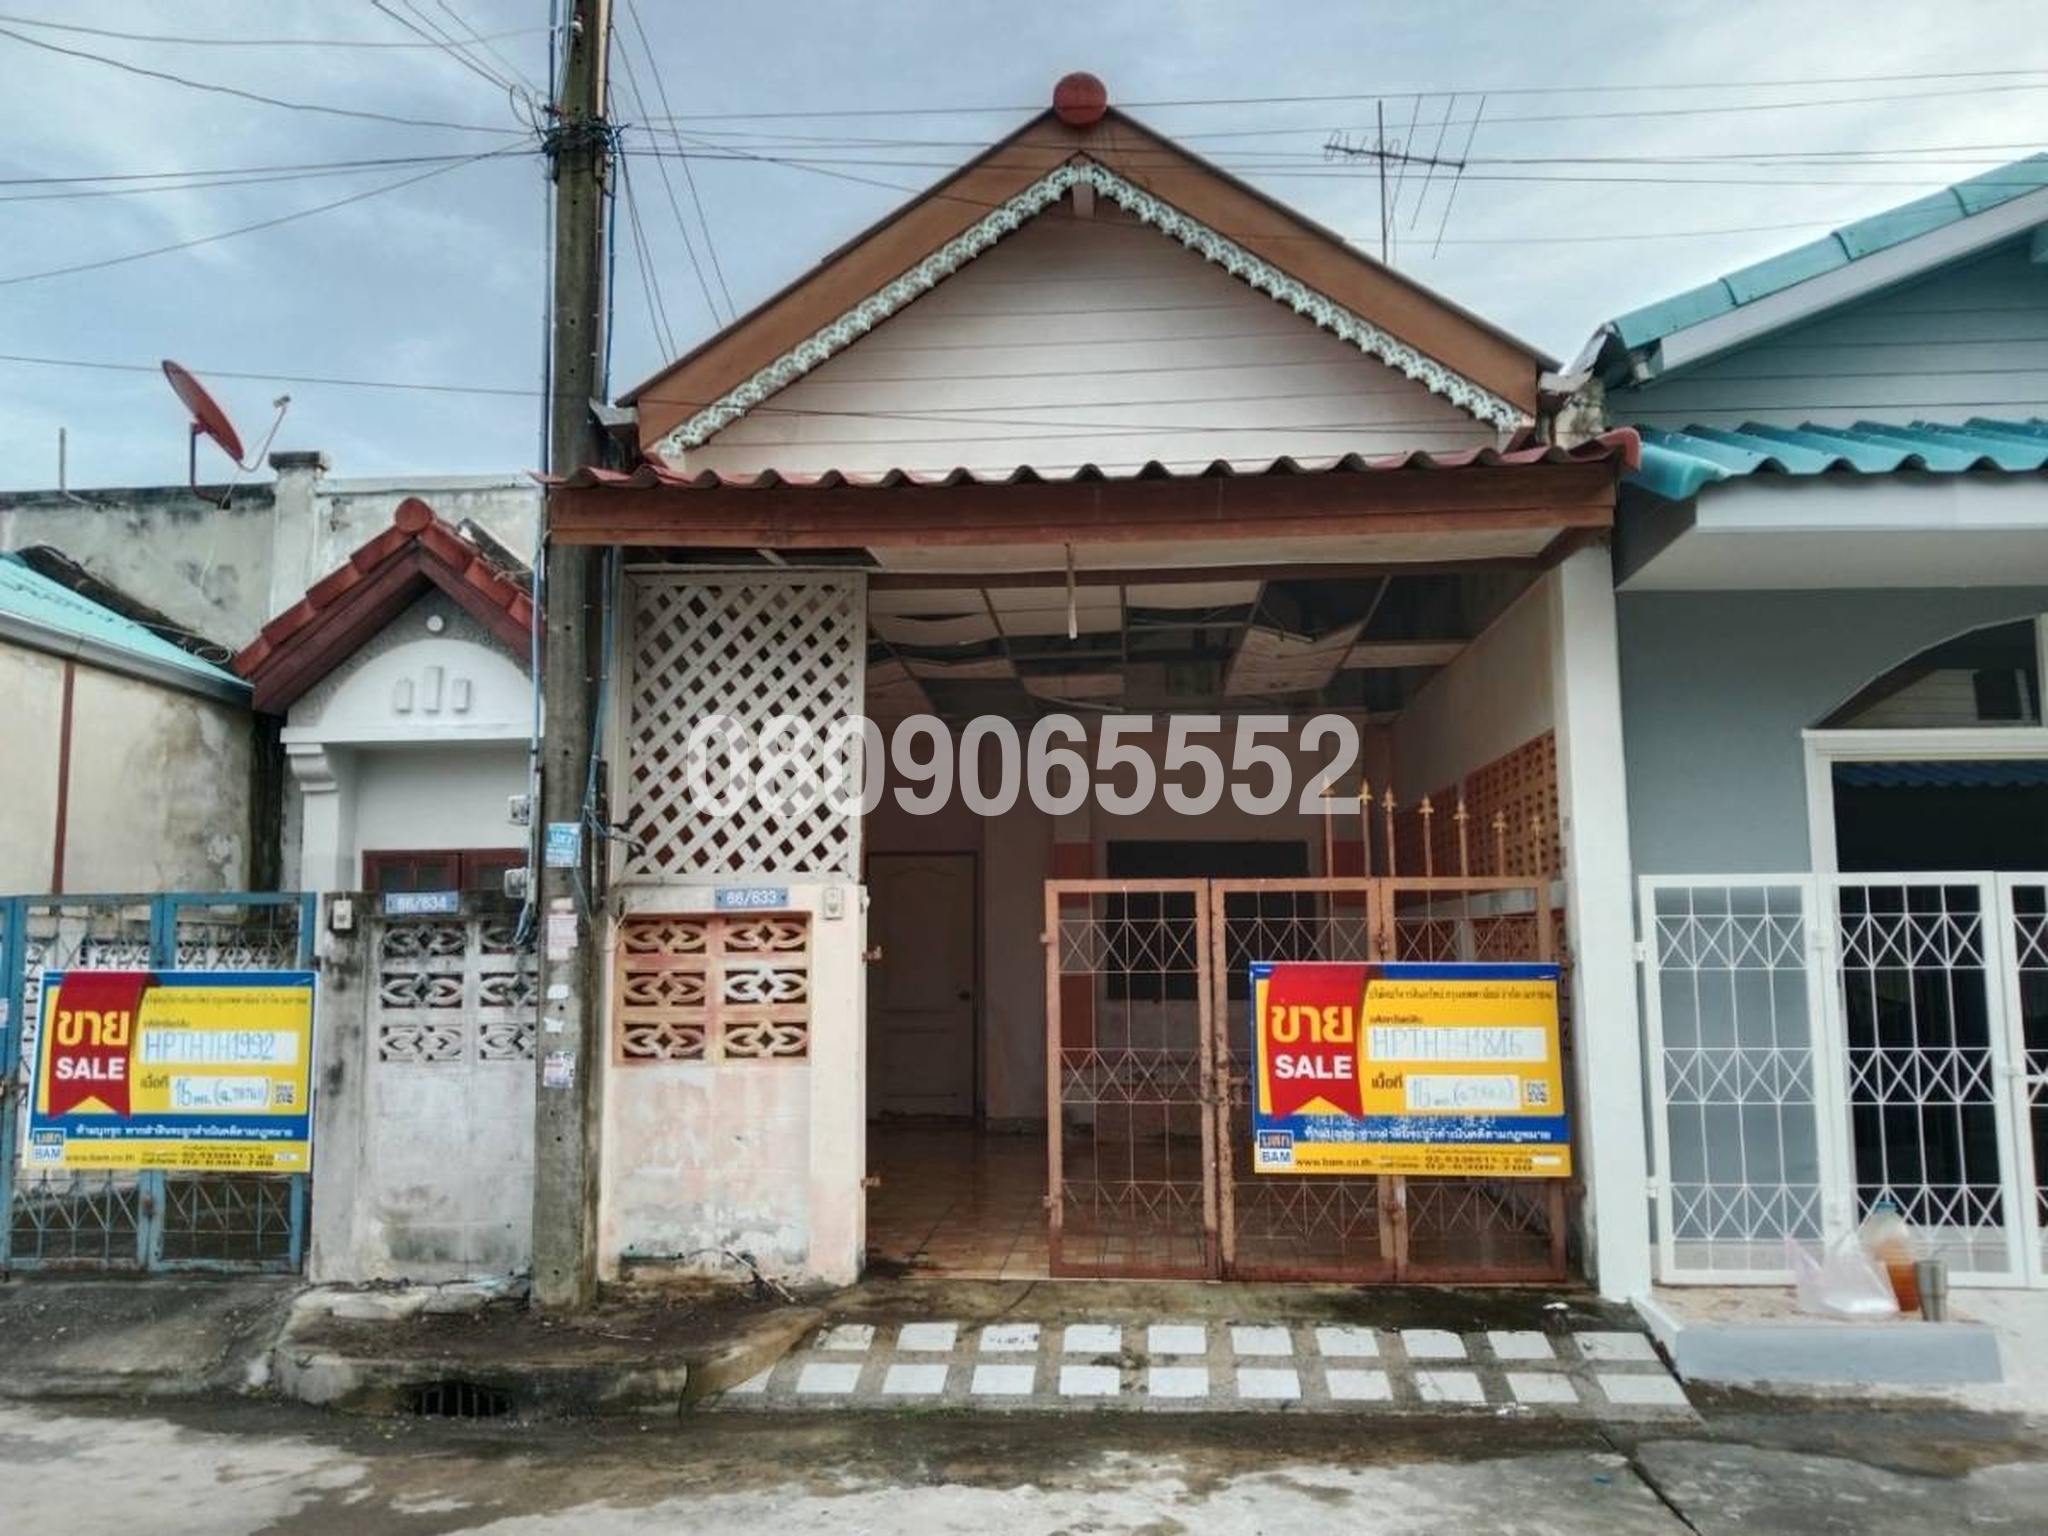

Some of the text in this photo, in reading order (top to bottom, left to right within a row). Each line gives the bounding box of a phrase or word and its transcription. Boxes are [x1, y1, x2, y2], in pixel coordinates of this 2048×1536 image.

[57, 1010, 129, 1047] ขาย
[1271, 1005, 1353, 1043] ขาย
[56, 1058, 125, 1080] SALE
[1275, 1055, 1352, 1080] SALE
[1262, 1149, 1291, 1163] BAM
